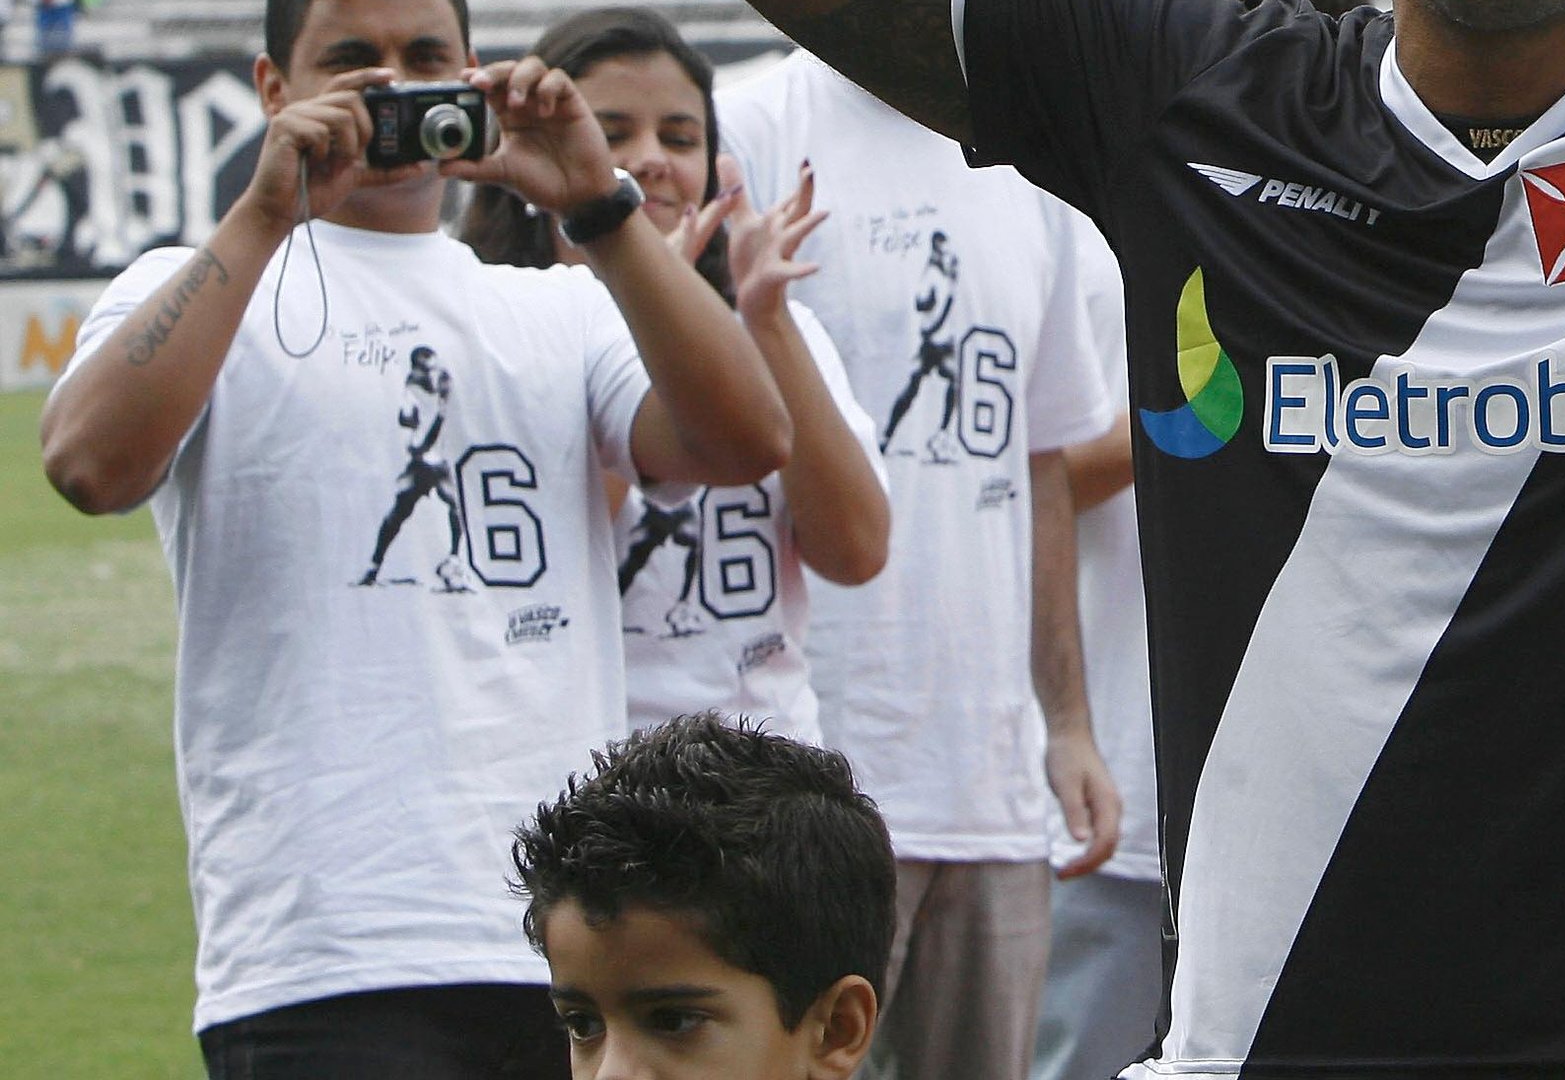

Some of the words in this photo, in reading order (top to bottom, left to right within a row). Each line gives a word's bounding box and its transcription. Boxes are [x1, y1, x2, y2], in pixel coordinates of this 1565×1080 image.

[1469, 128, 1525, 148] VASC
[957, 326, 1017, 459] 6
[455, 444, 548, 588] 6
[700, 483, 777, 620] 6
